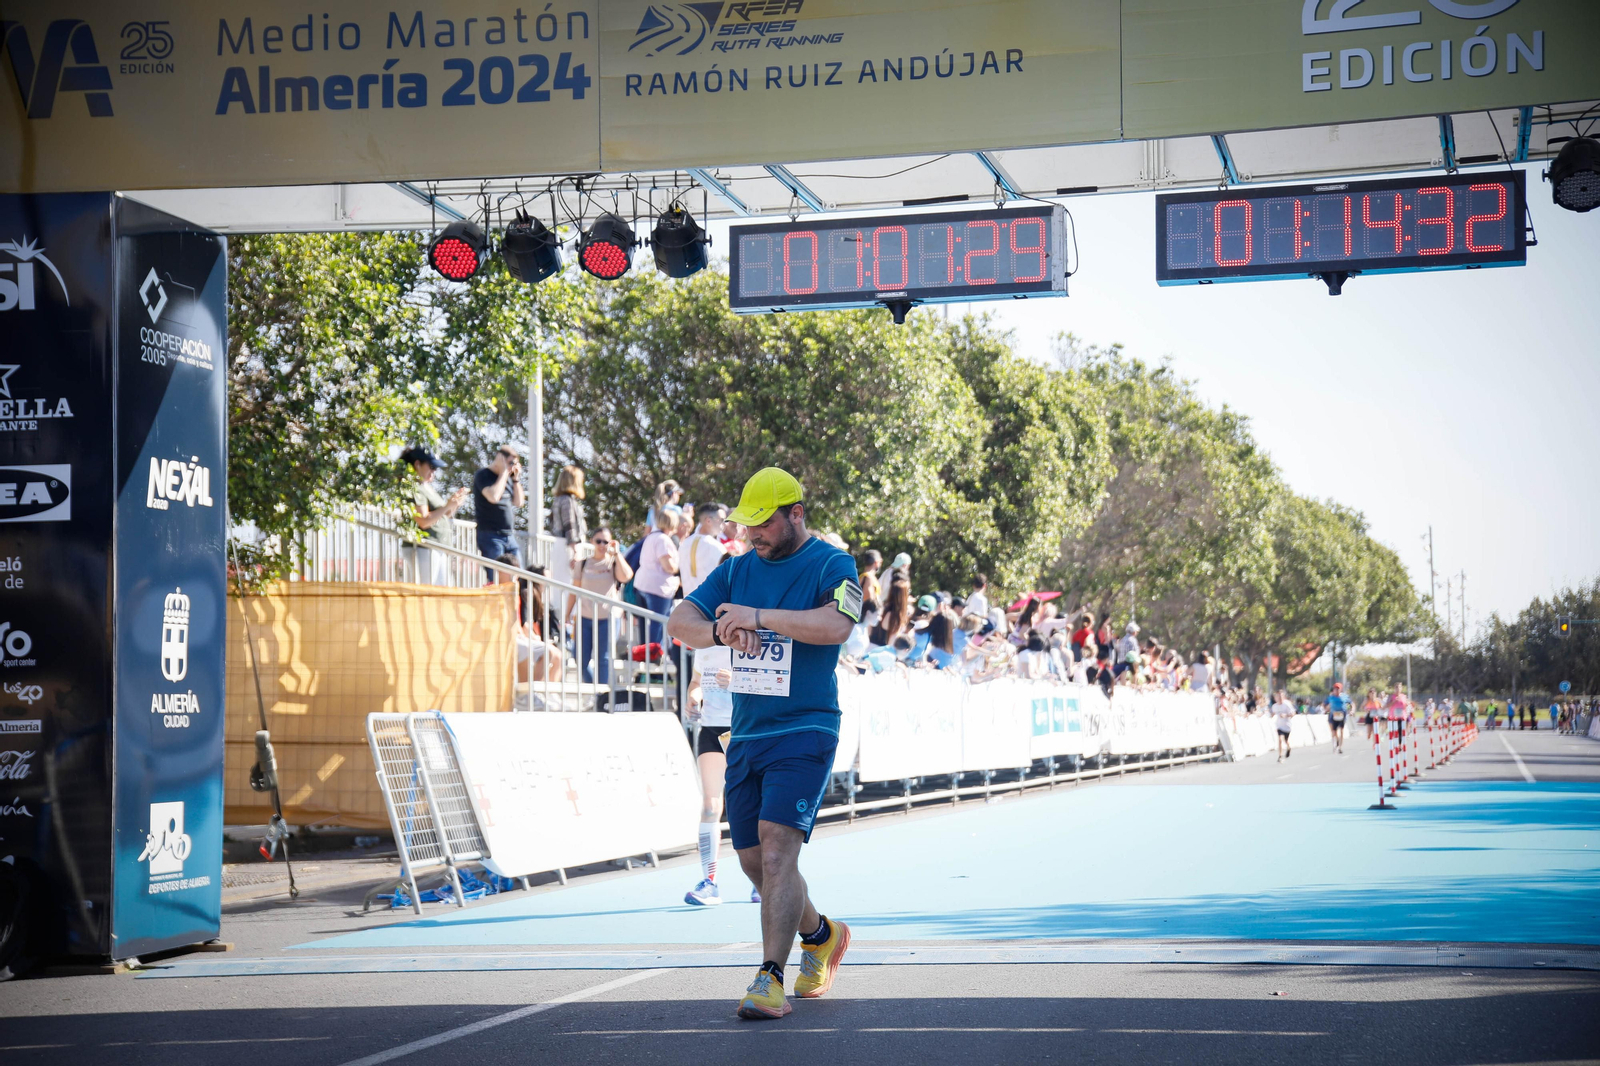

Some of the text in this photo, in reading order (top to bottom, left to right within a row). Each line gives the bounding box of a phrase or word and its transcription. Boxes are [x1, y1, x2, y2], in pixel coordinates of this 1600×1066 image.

[217, 3, 589, 56] Medio Maratón
[717, 20, 797, 36] SERIES
[120, 21, 174, 60] 25
[711, 33, 845, 53] RUTA RUNNING
[119, 61, 175, 74] EDICIÓN
[1302, 25, 1545, 92] EDICIÓN
[215, 51, 591, 115] Almería 2024
[625, 47, 1025, 96] RAMÓN RUIZ ANDÚJAR
[140, 327, 212, 361] COOPERACIÓN
[141, 345, 166, 366] 2005
[5, 574, 24, 589] de
[4, 659, 18, 668] sport
[151, 690, 200, 713] ALMERÍA
[163, 715, 190, 728] CIUDAD
[0, 750, 36, 780] ola
